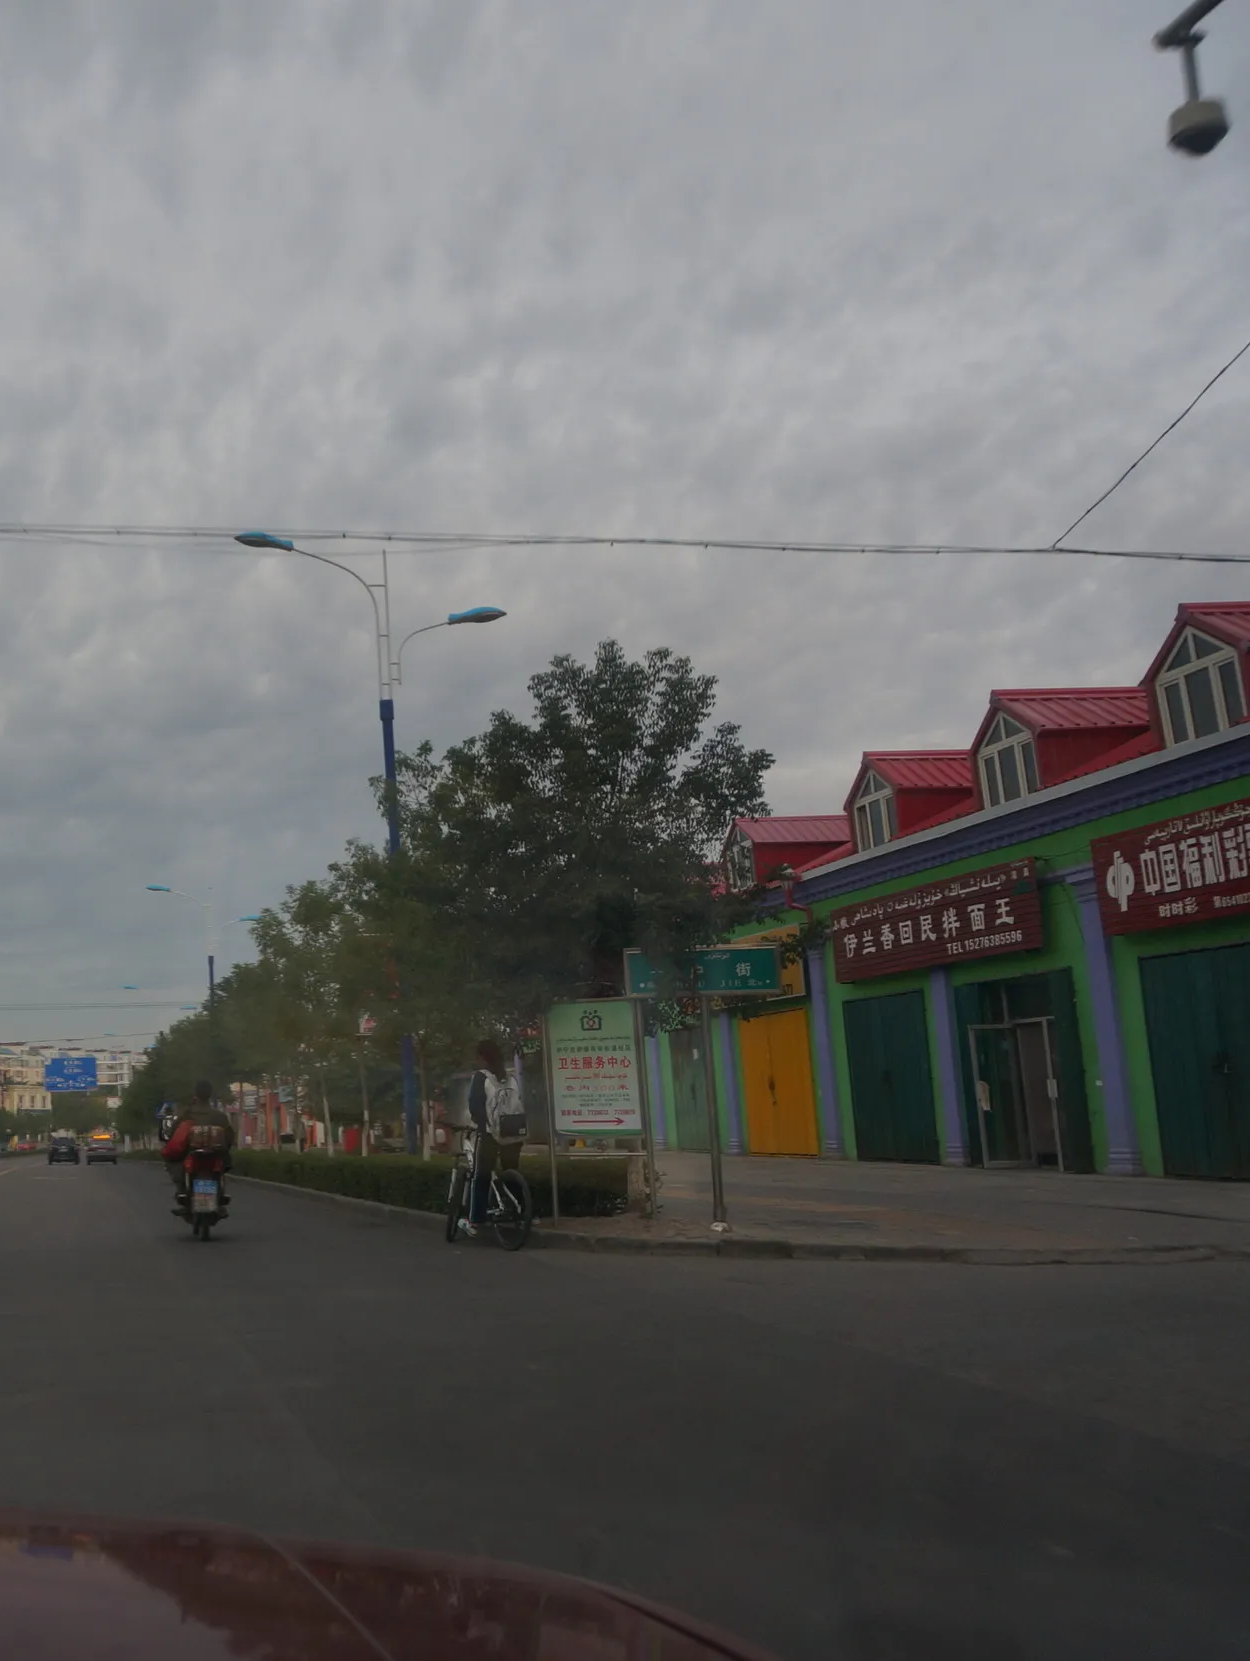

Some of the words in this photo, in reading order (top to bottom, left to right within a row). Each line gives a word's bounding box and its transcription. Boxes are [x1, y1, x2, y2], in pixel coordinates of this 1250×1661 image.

[1139, 823, 1250, 896] 中国福利彩
[1158, 896, 1199, 918] 时时彩
[843, 898, 1015, 958] 伊兰香回民拌面王
[946, 942, 964, 956] TEL
[965, 930, 1023, 952] 15276385596
[735, 961, 752, 977] 街
[558, 1056, 631, 1070] 卫生服务中心
